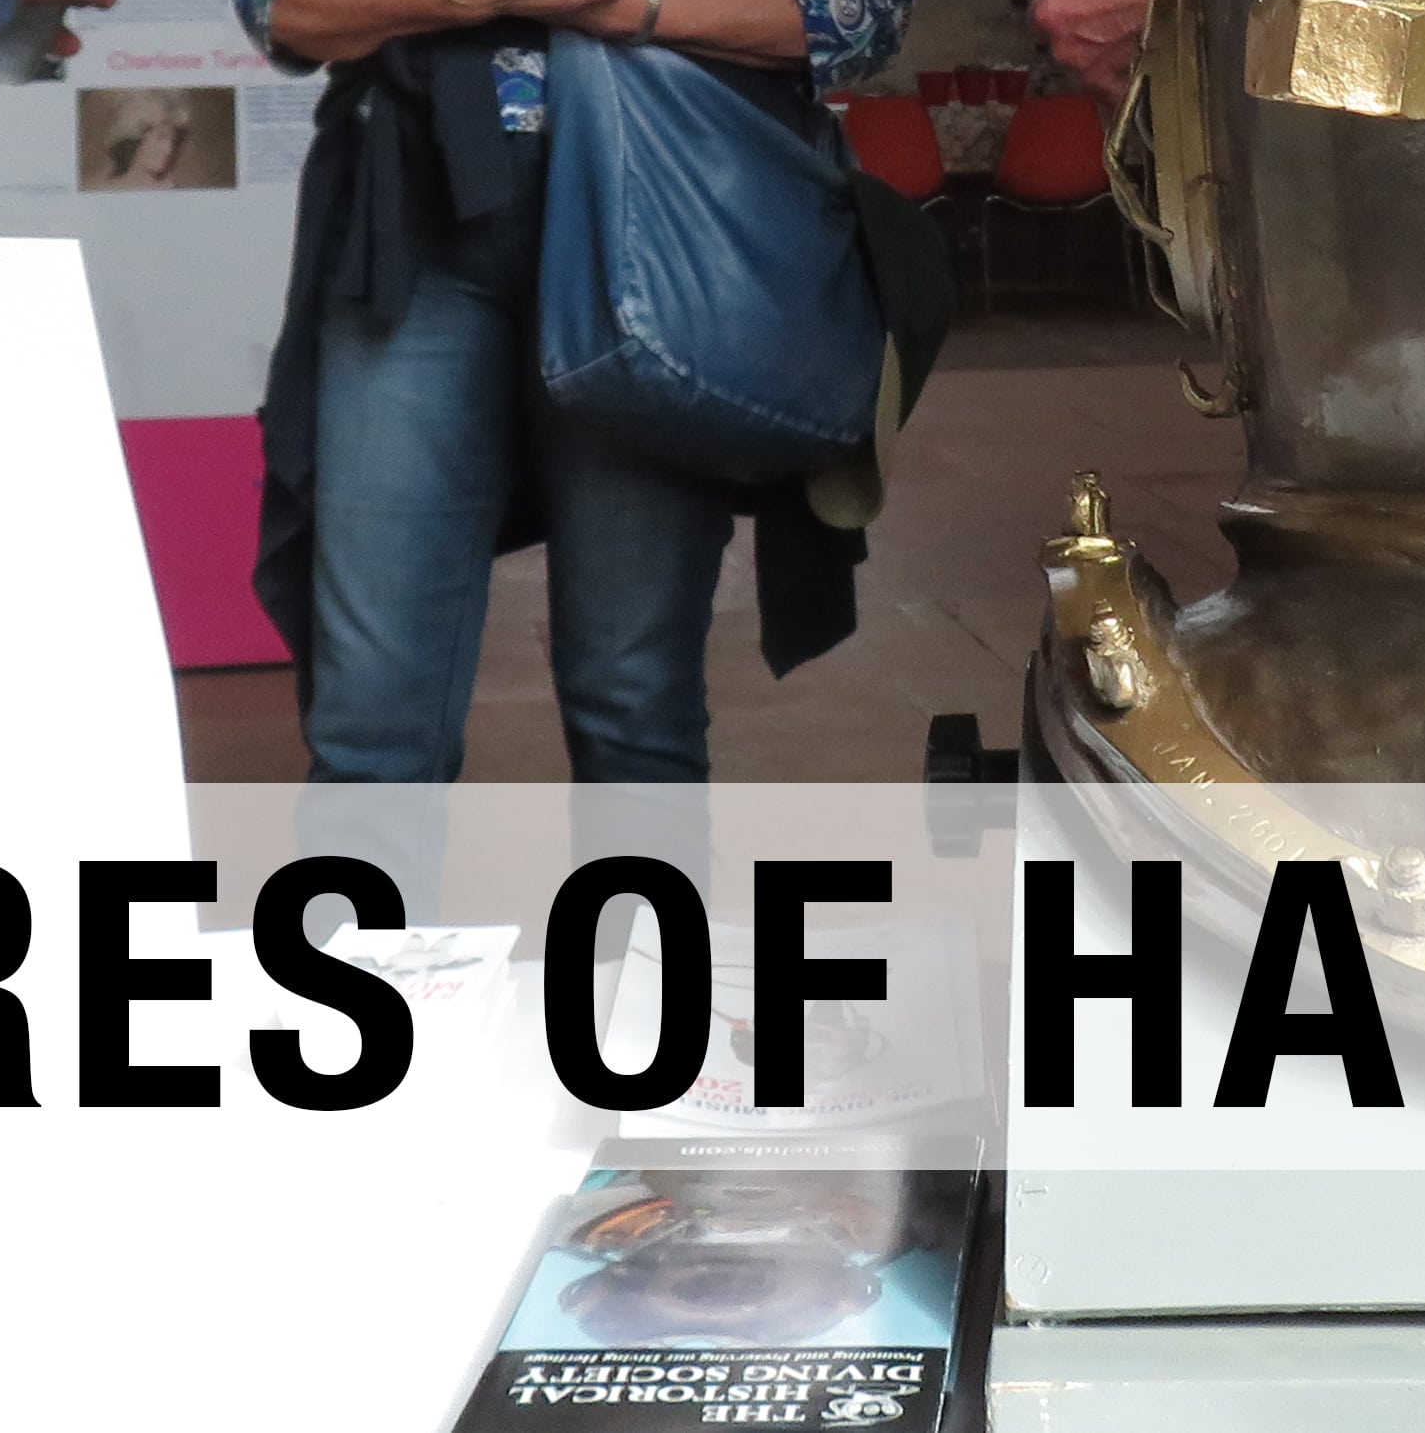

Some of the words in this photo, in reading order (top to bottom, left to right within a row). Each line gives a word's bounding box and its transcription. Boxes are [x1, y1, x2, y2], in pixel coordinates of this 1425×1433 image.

[1153, 743, 1217, 806] JAN.
[514, 1365, 730, 1385] SOCIETY
[742, 1364, 924, 1383] DIVING
[509, 1384, 811, 1405] HISTORICAL
[702, 1403, 806, 1423] THE
